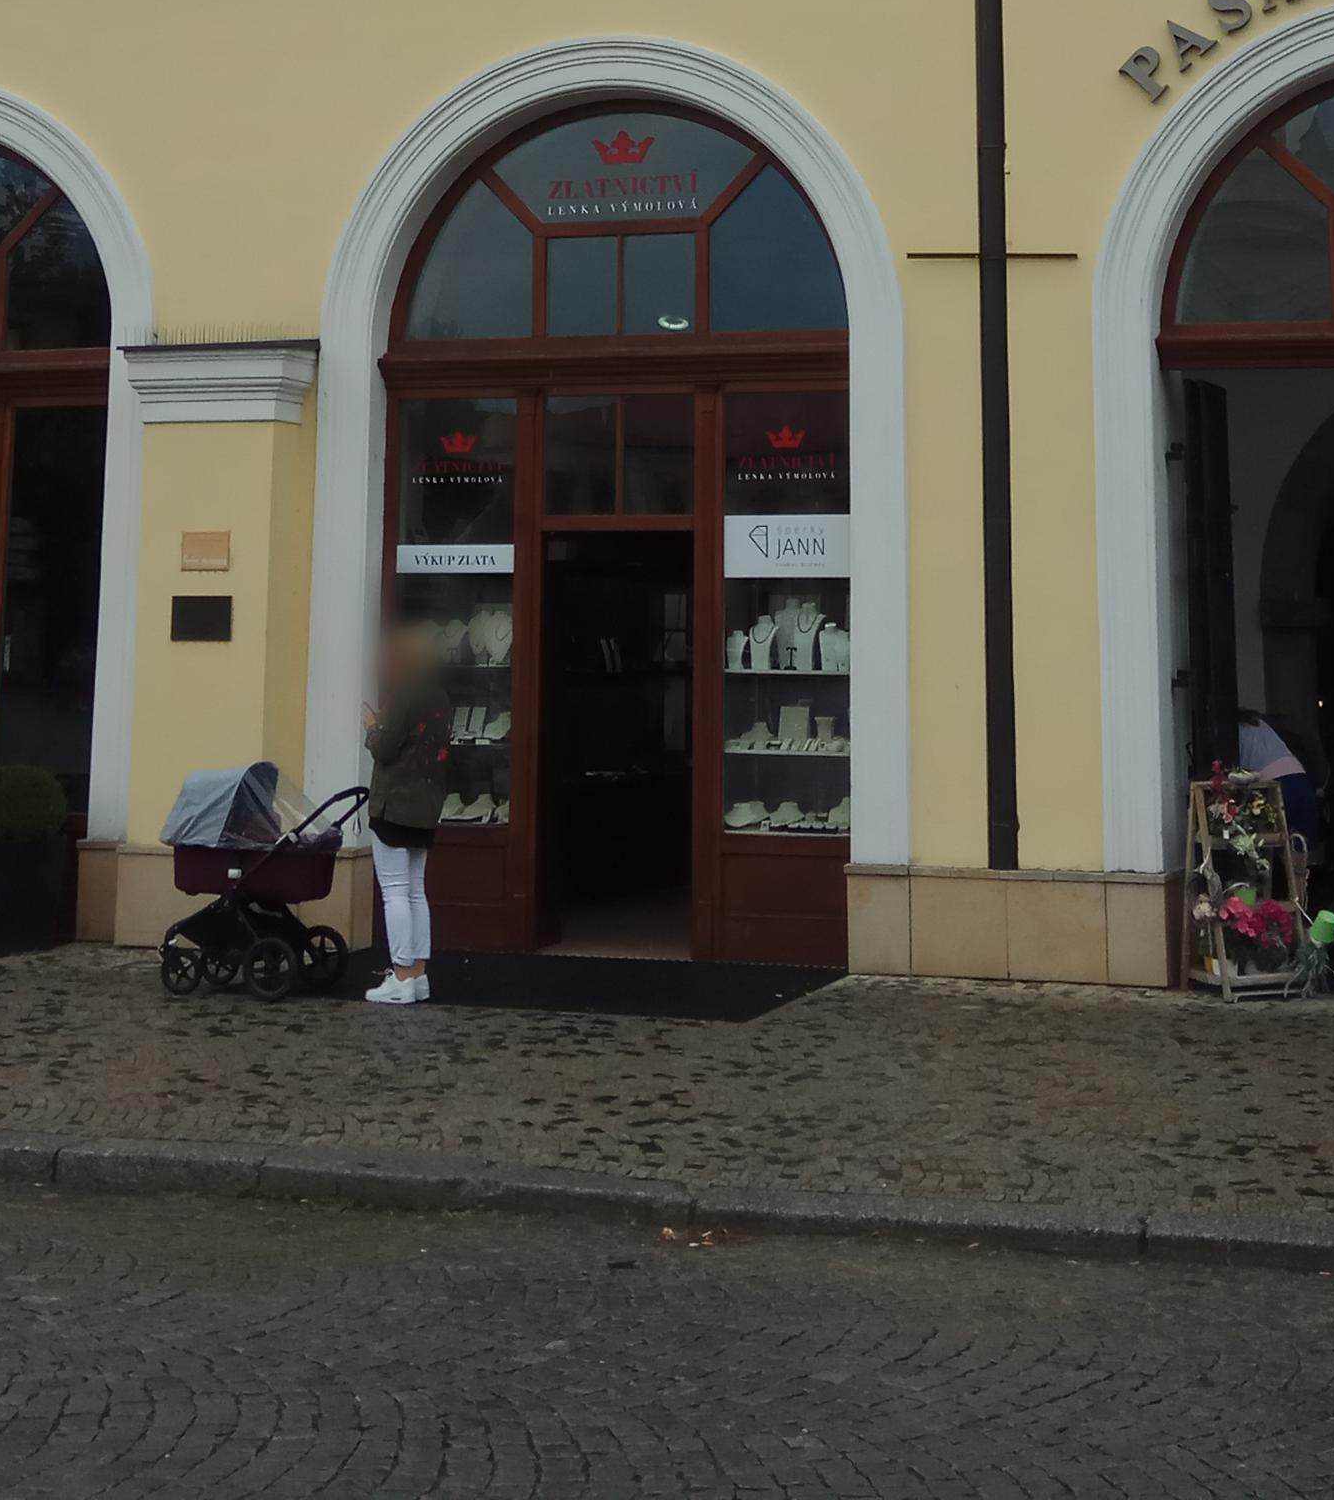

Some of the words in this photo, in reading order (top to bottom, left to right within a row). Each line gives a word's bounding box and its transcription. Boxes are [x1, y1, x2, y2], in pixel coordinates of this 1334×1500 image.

[548, 168, 699, 200] ZLATNICTVÍ
[547, 204, 602, 217] LENKA
[610, 197, 699, 213] VÝMOLOVÁ
[414, 552, 456, 566] VÝKUP
[458, 554, 496, 566] ZLATA
[776, 538, 825, 560] JANN
